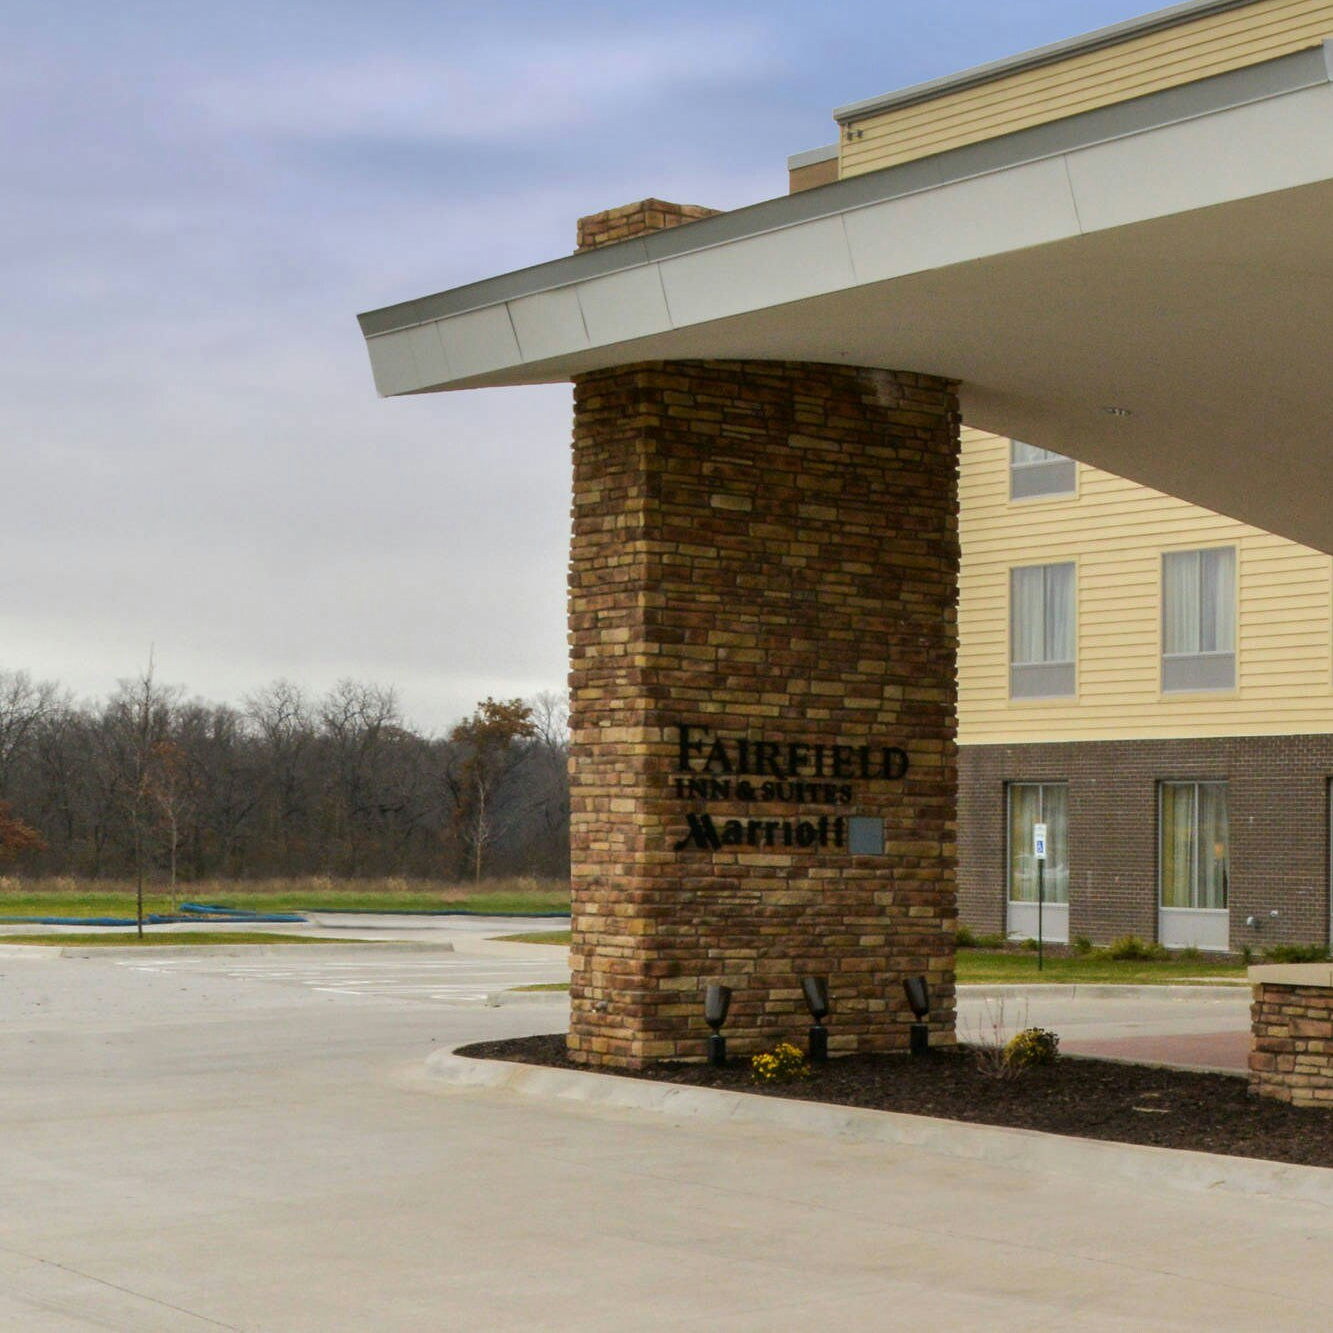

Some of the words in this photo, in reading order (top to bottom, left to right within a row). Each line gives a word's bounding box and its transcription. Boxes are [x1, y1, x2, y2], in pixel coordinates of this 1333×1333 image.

[677, 723, 909, 780] FAIRFIELD
[761, 781, 853, 804] SUITES
[673, 812, 847, 852] Marriott
